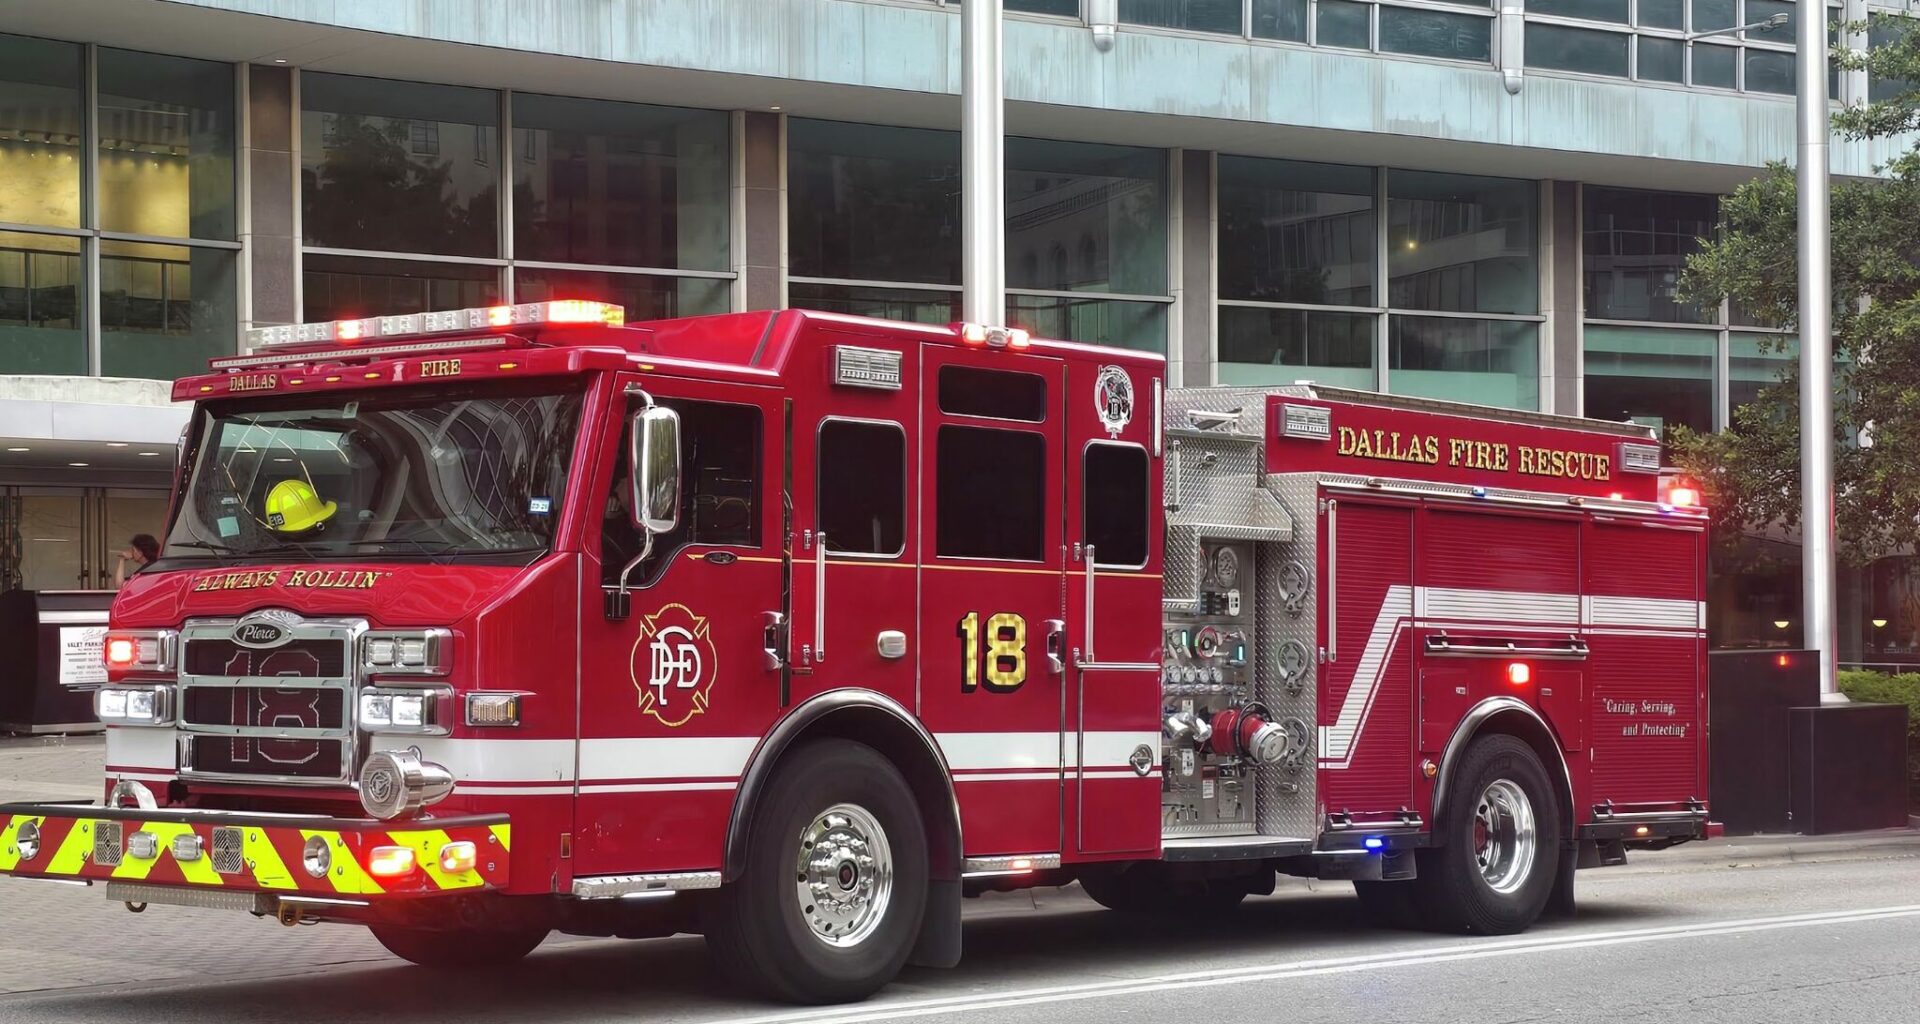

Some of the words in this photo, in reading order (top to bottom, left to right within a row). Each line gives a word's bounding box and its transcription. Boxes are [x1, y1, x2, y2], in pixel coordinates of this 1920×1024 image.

[229, 374, 276, 391] DALLAS
[420, 359, 461, 377] FIRE
[1337, 426, 1439, 464] DALLAS
[1448, 438, 1508, 471] FIRE
[1518, 446, 1610, 480] RESCUE
[242, 625, 276, 641] Pierce
[960, 612, 1027, 694] 18
[225, 650, 319, 763] 18
[1603, 698, 1638, 716] "Caring,
[1641, 699, 1676, 716] Serving,
[1622, 723, 1638, 736] and
[1641, 722, 1690, 738] Protecting"
